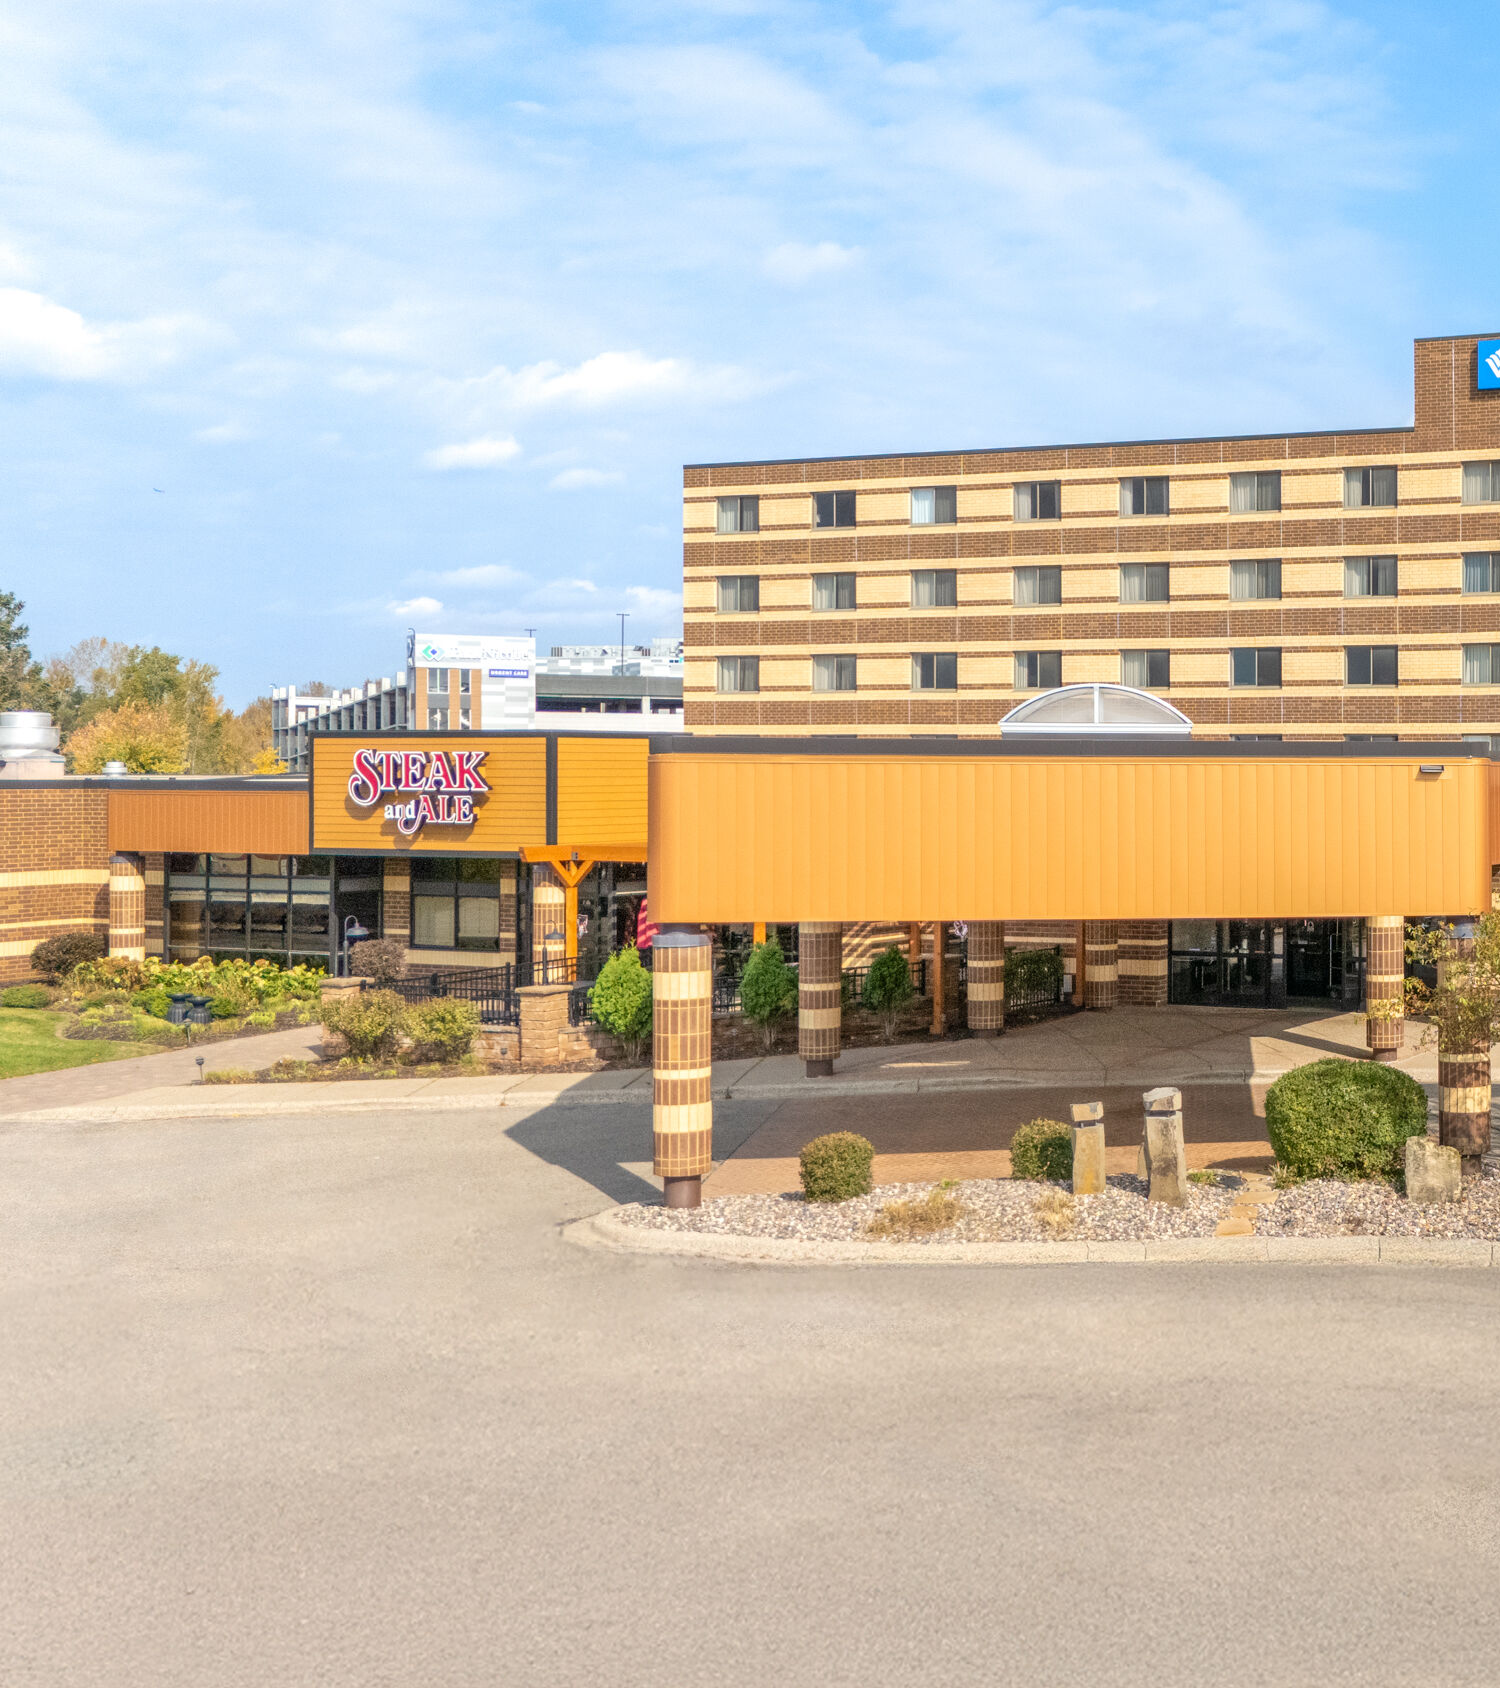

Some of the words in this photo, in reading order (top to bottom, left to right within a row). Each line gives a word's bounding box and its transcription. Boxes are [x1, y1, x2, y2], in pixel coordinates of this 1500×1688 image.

[348, 748, 489, 806] STEAK
[384, 799, 416, 819] and
[397, 795, 474, 835] ALE
